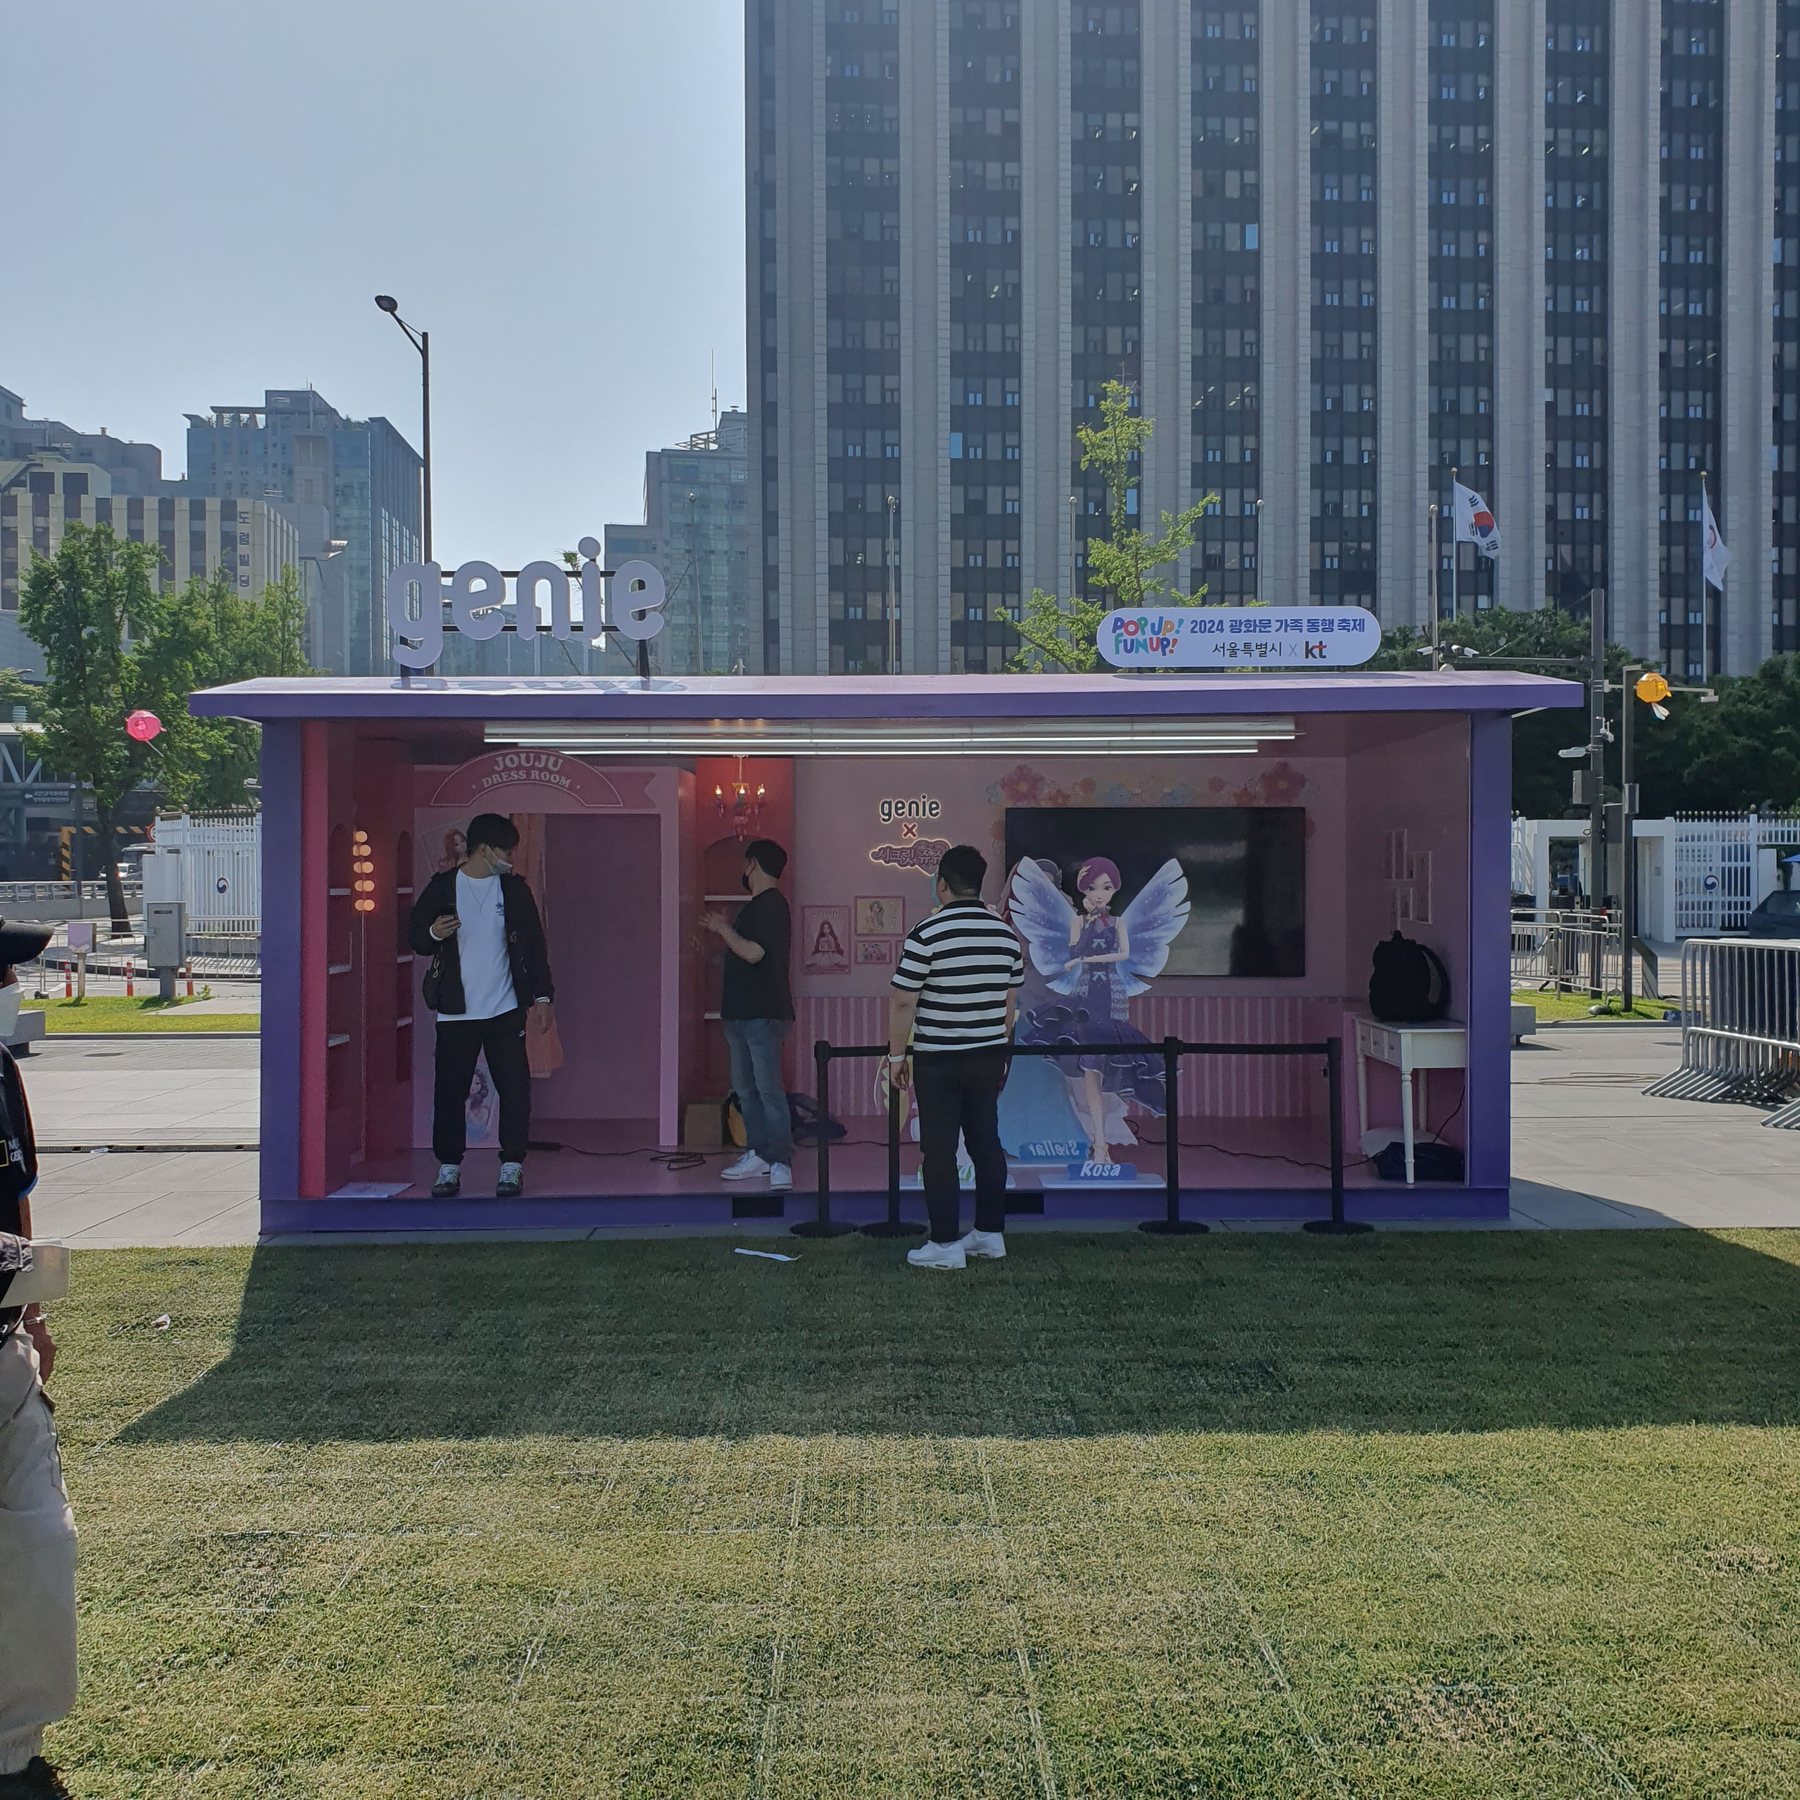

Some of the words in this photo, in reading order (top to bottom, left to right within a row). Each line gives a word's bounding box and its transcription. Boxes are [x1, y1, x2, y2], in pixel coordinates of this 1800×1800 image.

[388, 536, 666, 669] genie
[1190, 619, 1225, 634] 2024
[1228, 619, 1272, 634] 광화문
[1275, 619, 1304, 633] 가족
[1306, 618, 1335, 633] 동행
[1337, 618, 1366, 633] 축제
[1212, 641, 1282, 658] 서울특별시
[1304, 640, 1328, 659] kt
[493, 752, 564, 772] JOUJU
[481, 770, 528, 788] DRESS
[530, 770, 572, 788] ROOM
[879, 793, 941, 824] genie
[1079, 1160, 1122, 1177] Rosa
